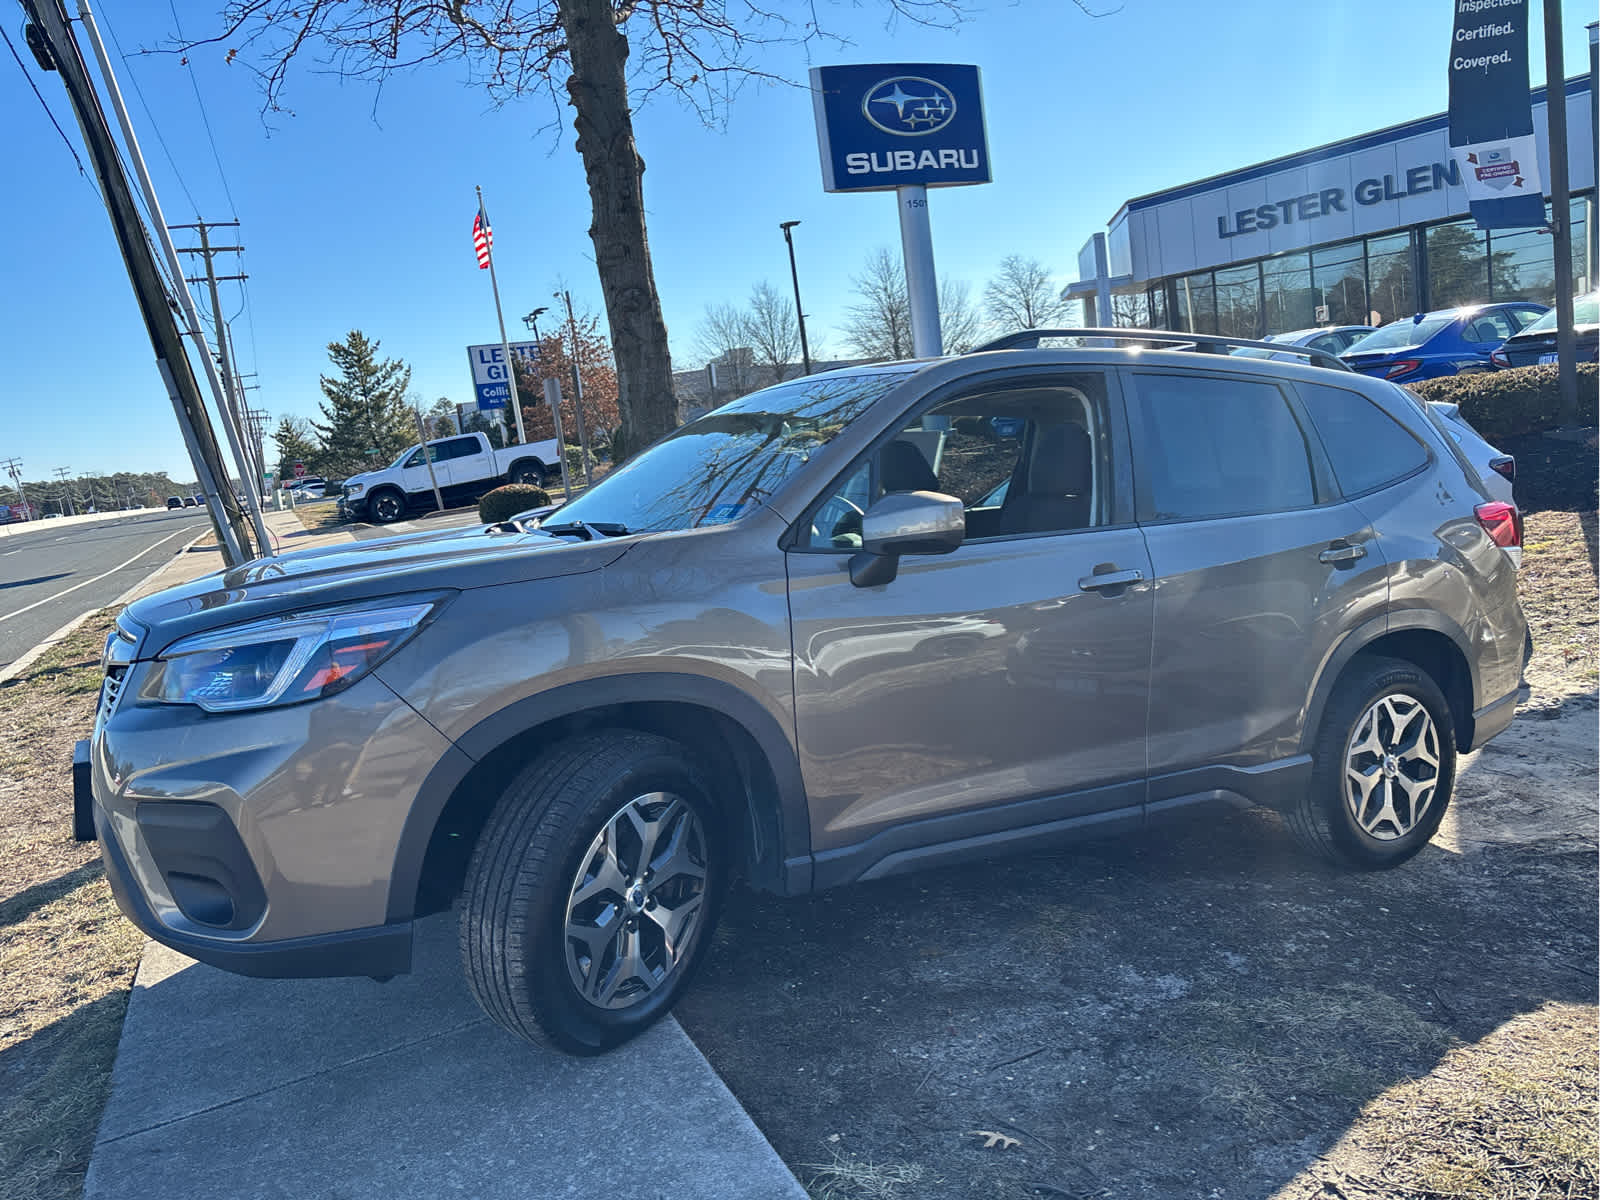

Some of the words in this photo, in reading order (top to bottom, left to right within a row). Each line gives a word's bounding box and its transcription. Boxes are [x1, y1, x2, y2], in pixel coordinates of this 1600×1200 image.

[1456, 21, 1515, 41] Certified.
[1454, 50, 1512, 70] Covered.
[846, 149, 979, 174] SUBARU
[1217, 188, 1347, 239] LESTER
[1354, 158, 1460, 206] GLEN
